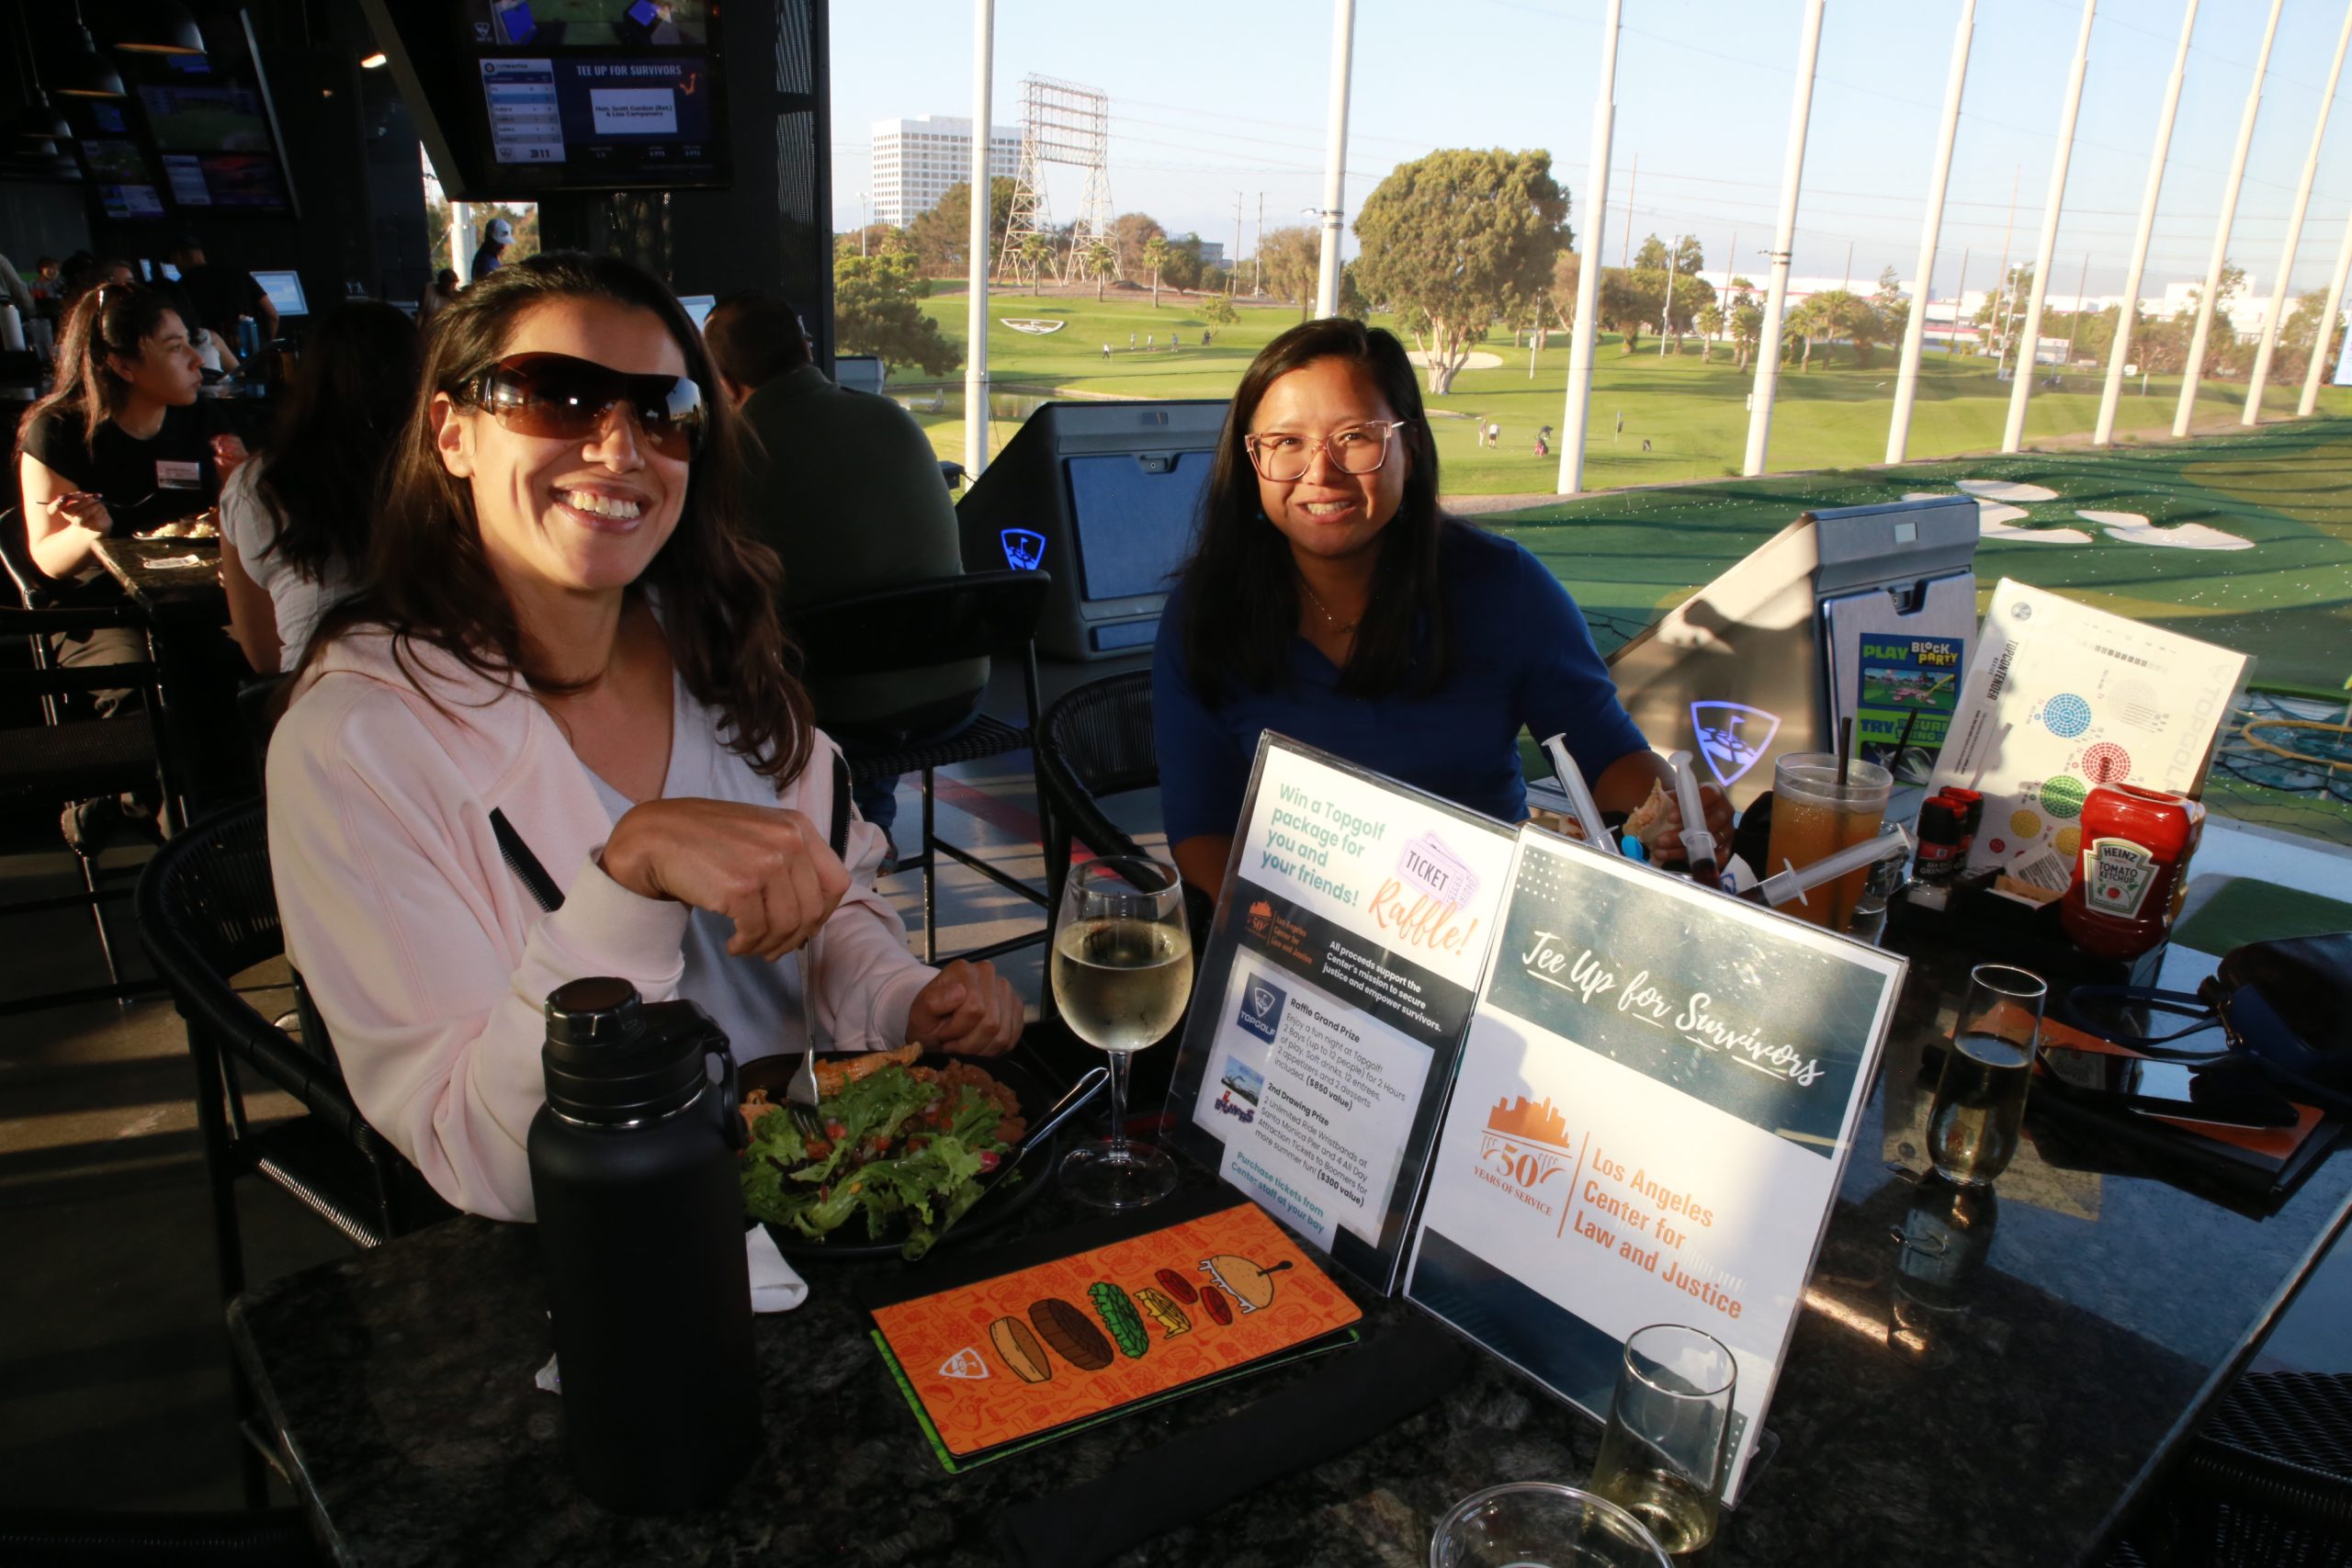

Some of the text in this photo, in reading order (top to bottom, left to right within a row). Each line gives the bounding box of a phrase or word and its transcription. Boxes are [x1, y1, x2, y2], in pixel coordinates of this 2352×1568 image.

[576, 64, 682, 76] TEE UP FOR SURVIVORS
[530, 148, 550, 159] 311
[1863, 645, 1909, 660] PLAY
[1917, 652, 1958, 665] PARTY
[1987, 639, 2018, 701] TOPCONTENDER
[1860, 718, 1895, 734] TRY
[1270, 807, 1365, 858] package for
[1279, 783, 1386, 841] Win a Topgolf
[1266, 829, 1329, 868] you and
[1406, 850, 1450, 892] TICKET
[2099, 862, 2138, 877] TOMATO
[2104, 848, 2137, 863] HEINZ
[1260, 851, 1360, 908] your friends!
[2099, 871, 2135, 884] KETCHUP
[1368, 877, 1478, 956] Raffle!
[1326, 952, 1427, 1010] Center's mission to secure
[1329, 941, 1421, 993] All proceeds support the
[1240, 1010, 1276, 1035] TOPGOLF
[1290, 998, 1361, 1043] Raffle Grand Prize
[1321, 962, 1442, 1032] justice and empower survivors.
[1521, 930, 1826, 1087] Tee Up for Survivors
[1280, 1036, 1289, 1045] of
[1305, 1050, 1320, 1065] Soft
[1344, 1071, 1352, 1083] 12
[1283, 1022, 1407, 1102] 2 Bays (up to 12 people) for 2 Hours
[1285, 1011, 1384, 1073] Enjoy a fun night at Topgolf!
[1267, 1081, 1329, 1126] 2nd Drawing Prize
[1274, 1059, 1353, 1111] included. ($850 value)
[1277, 1045, 1372, 1109] 2 appetizers and 2 desserts
[1257, 1118, 1368, 1196] Attraction Tickets to Boomers for
[1261, 1106, 1368, 1184] Santa Monica Pier and 4 All Day
[1263, 1095, 1368, 1168] 2 Unlimited Ride Wristbands at
[1237, 1151, 1324, 1218] Purchase tickets from
[1255, 1129, 1365, 1209] more summer fun! ($300 value)
[1474, 1166, 1553, 1217] YEARS OF SERVICE
[1497, 1143, 1540, 1188] 50
[1591, 1147, 1713, 1228] Los Angeles
[1231, 1161, 1325, 1235] Center staff at your bay
[1583, 1179, 1686, 1250] Center for
[1574, 1210, 1743, 1320] Law and Justice
